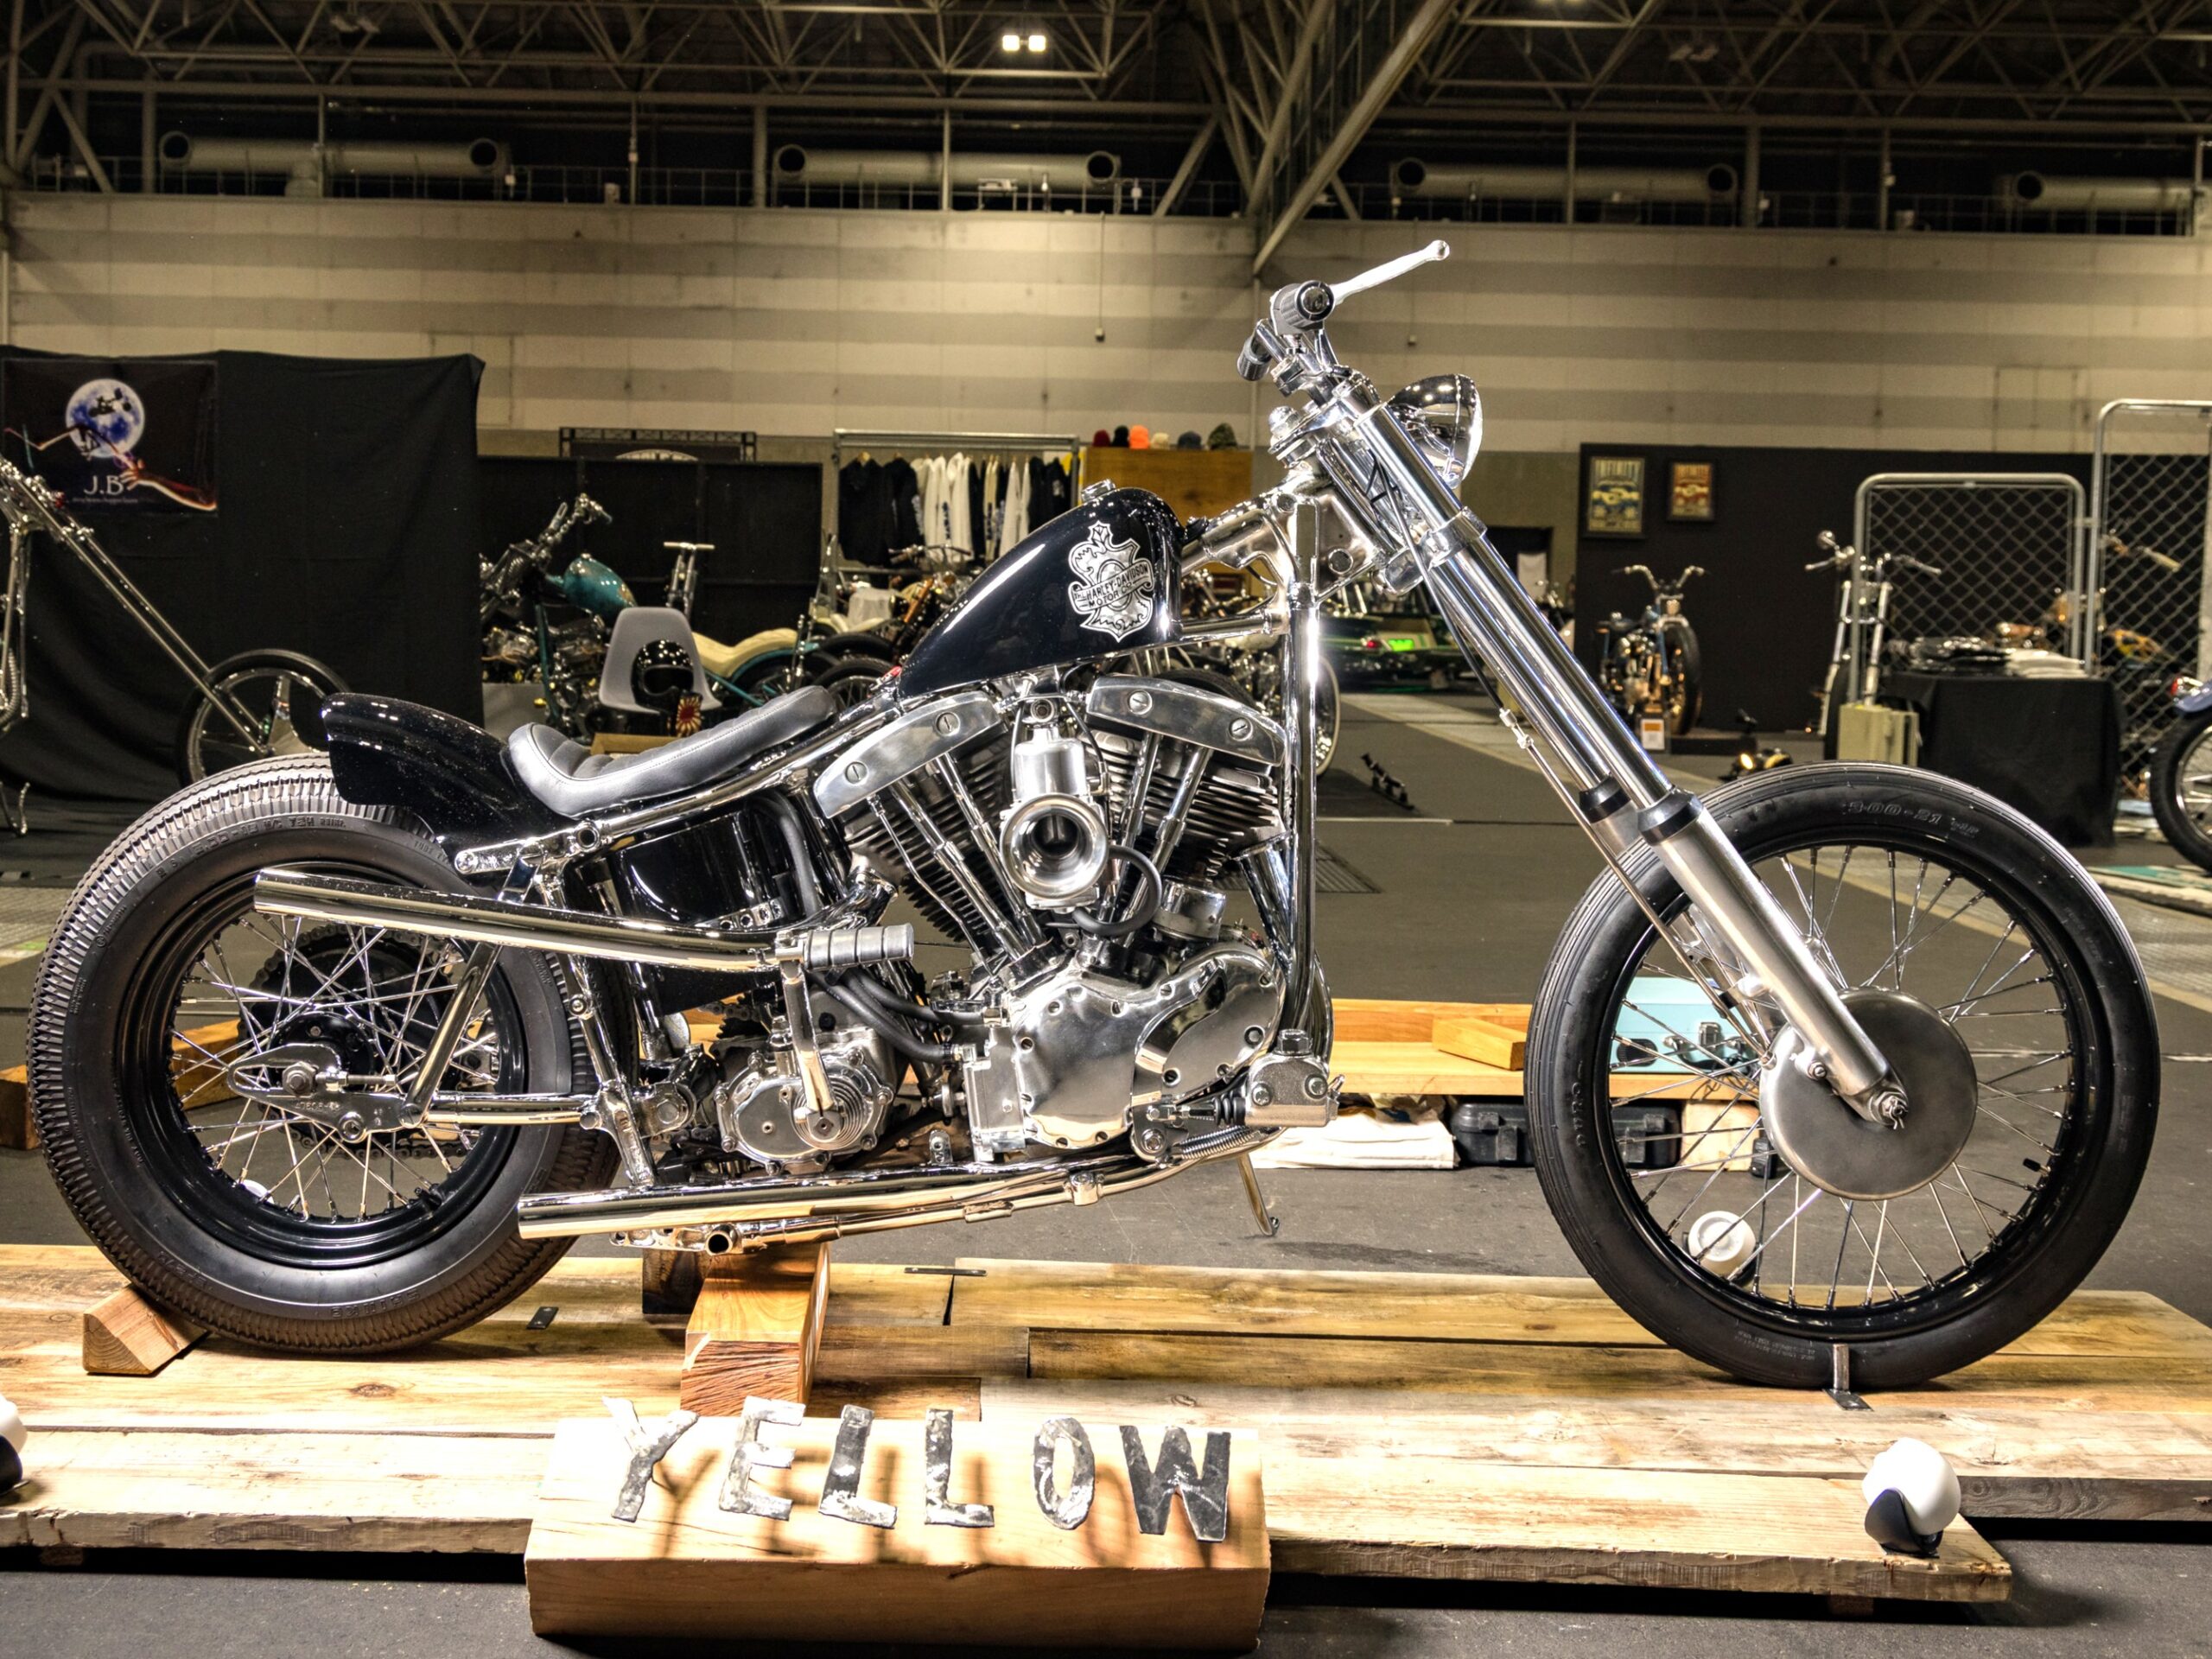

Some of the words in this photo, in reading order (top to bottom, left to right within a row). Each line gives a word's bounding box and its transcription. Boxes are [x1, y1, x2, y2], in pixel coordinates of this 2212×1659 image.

[1086, 563, 1149, 601] HARLEY-DAVIDSON
[1088, 590, 1121, 607] MOTOR
[601, 1395, 1232, 1542] YELLOW
